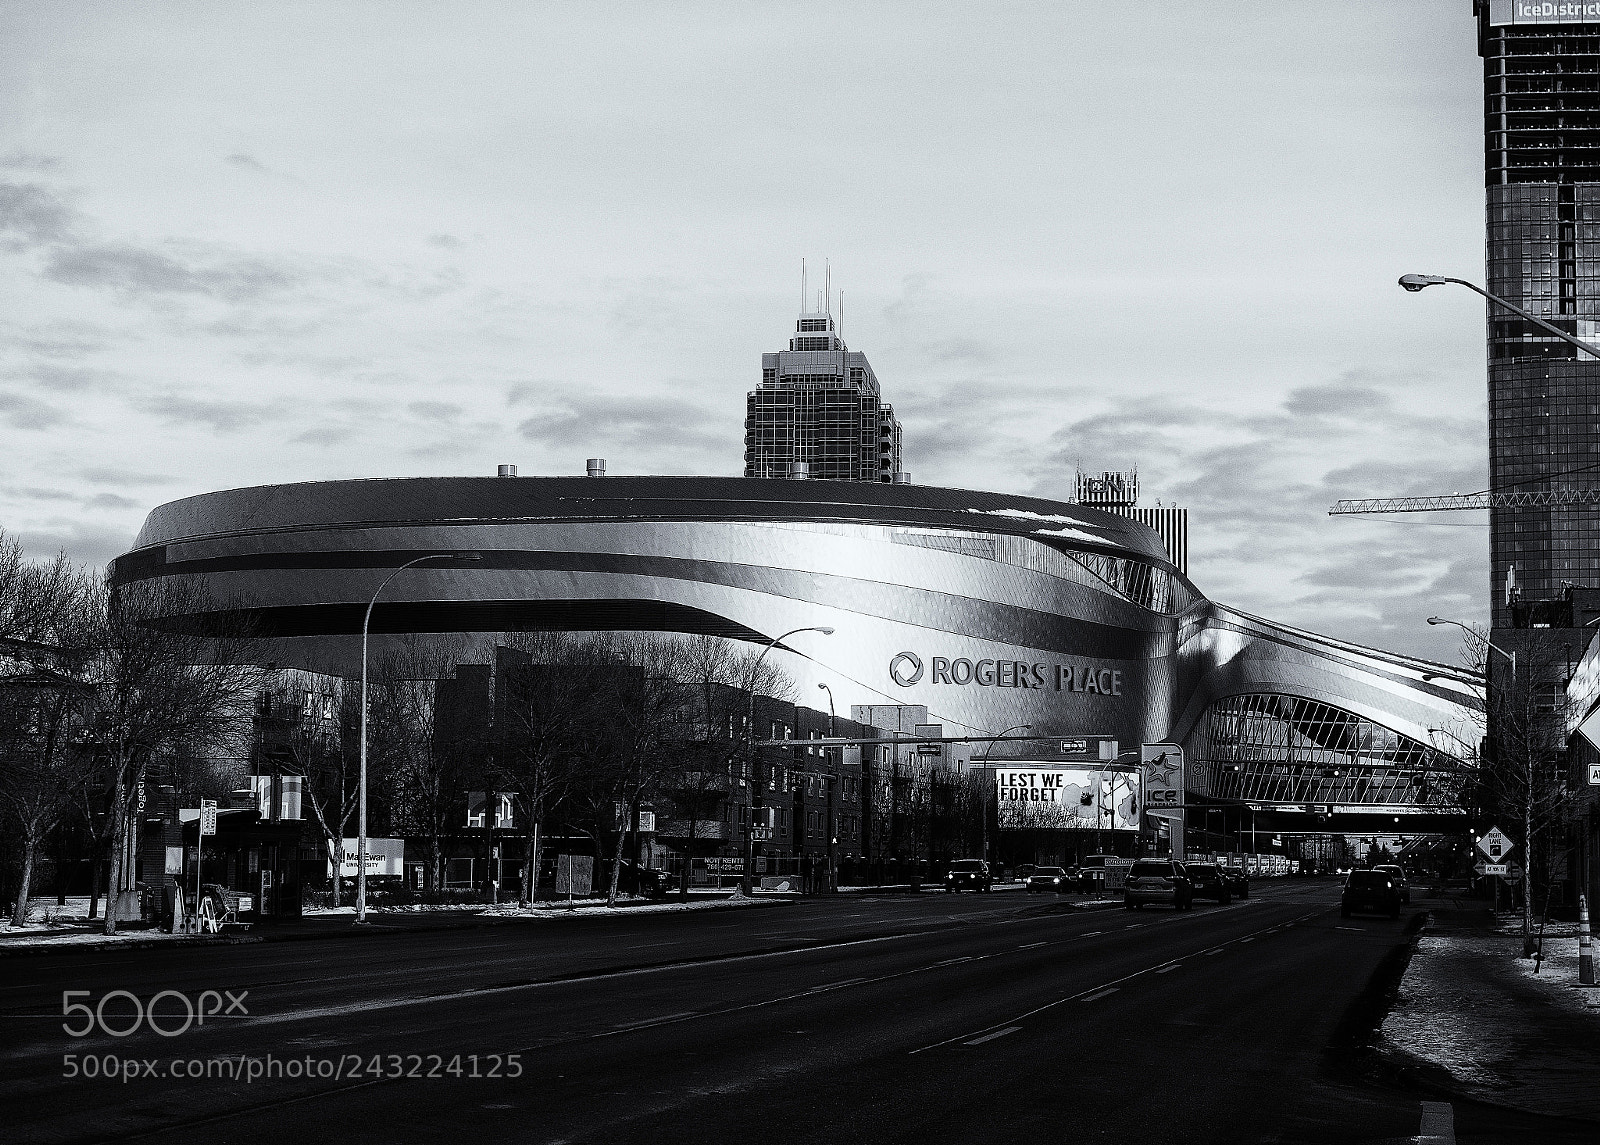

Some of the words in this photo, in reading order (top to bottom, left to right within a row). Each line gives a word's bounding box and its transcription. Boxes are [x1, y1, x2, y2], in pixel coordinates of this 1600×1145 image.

[932, 656, 1047, 690] ROGERS
[1056, 664, 1122, 696] PLACE
[1001, 773, 1037, 787] LEST
[1041, 773, 1063, 787] WE
[1592, 770, 1600, 779] A
[1001, 788, 1058, 801] FORGET
[346, 853, 386, 861] MaEwan
